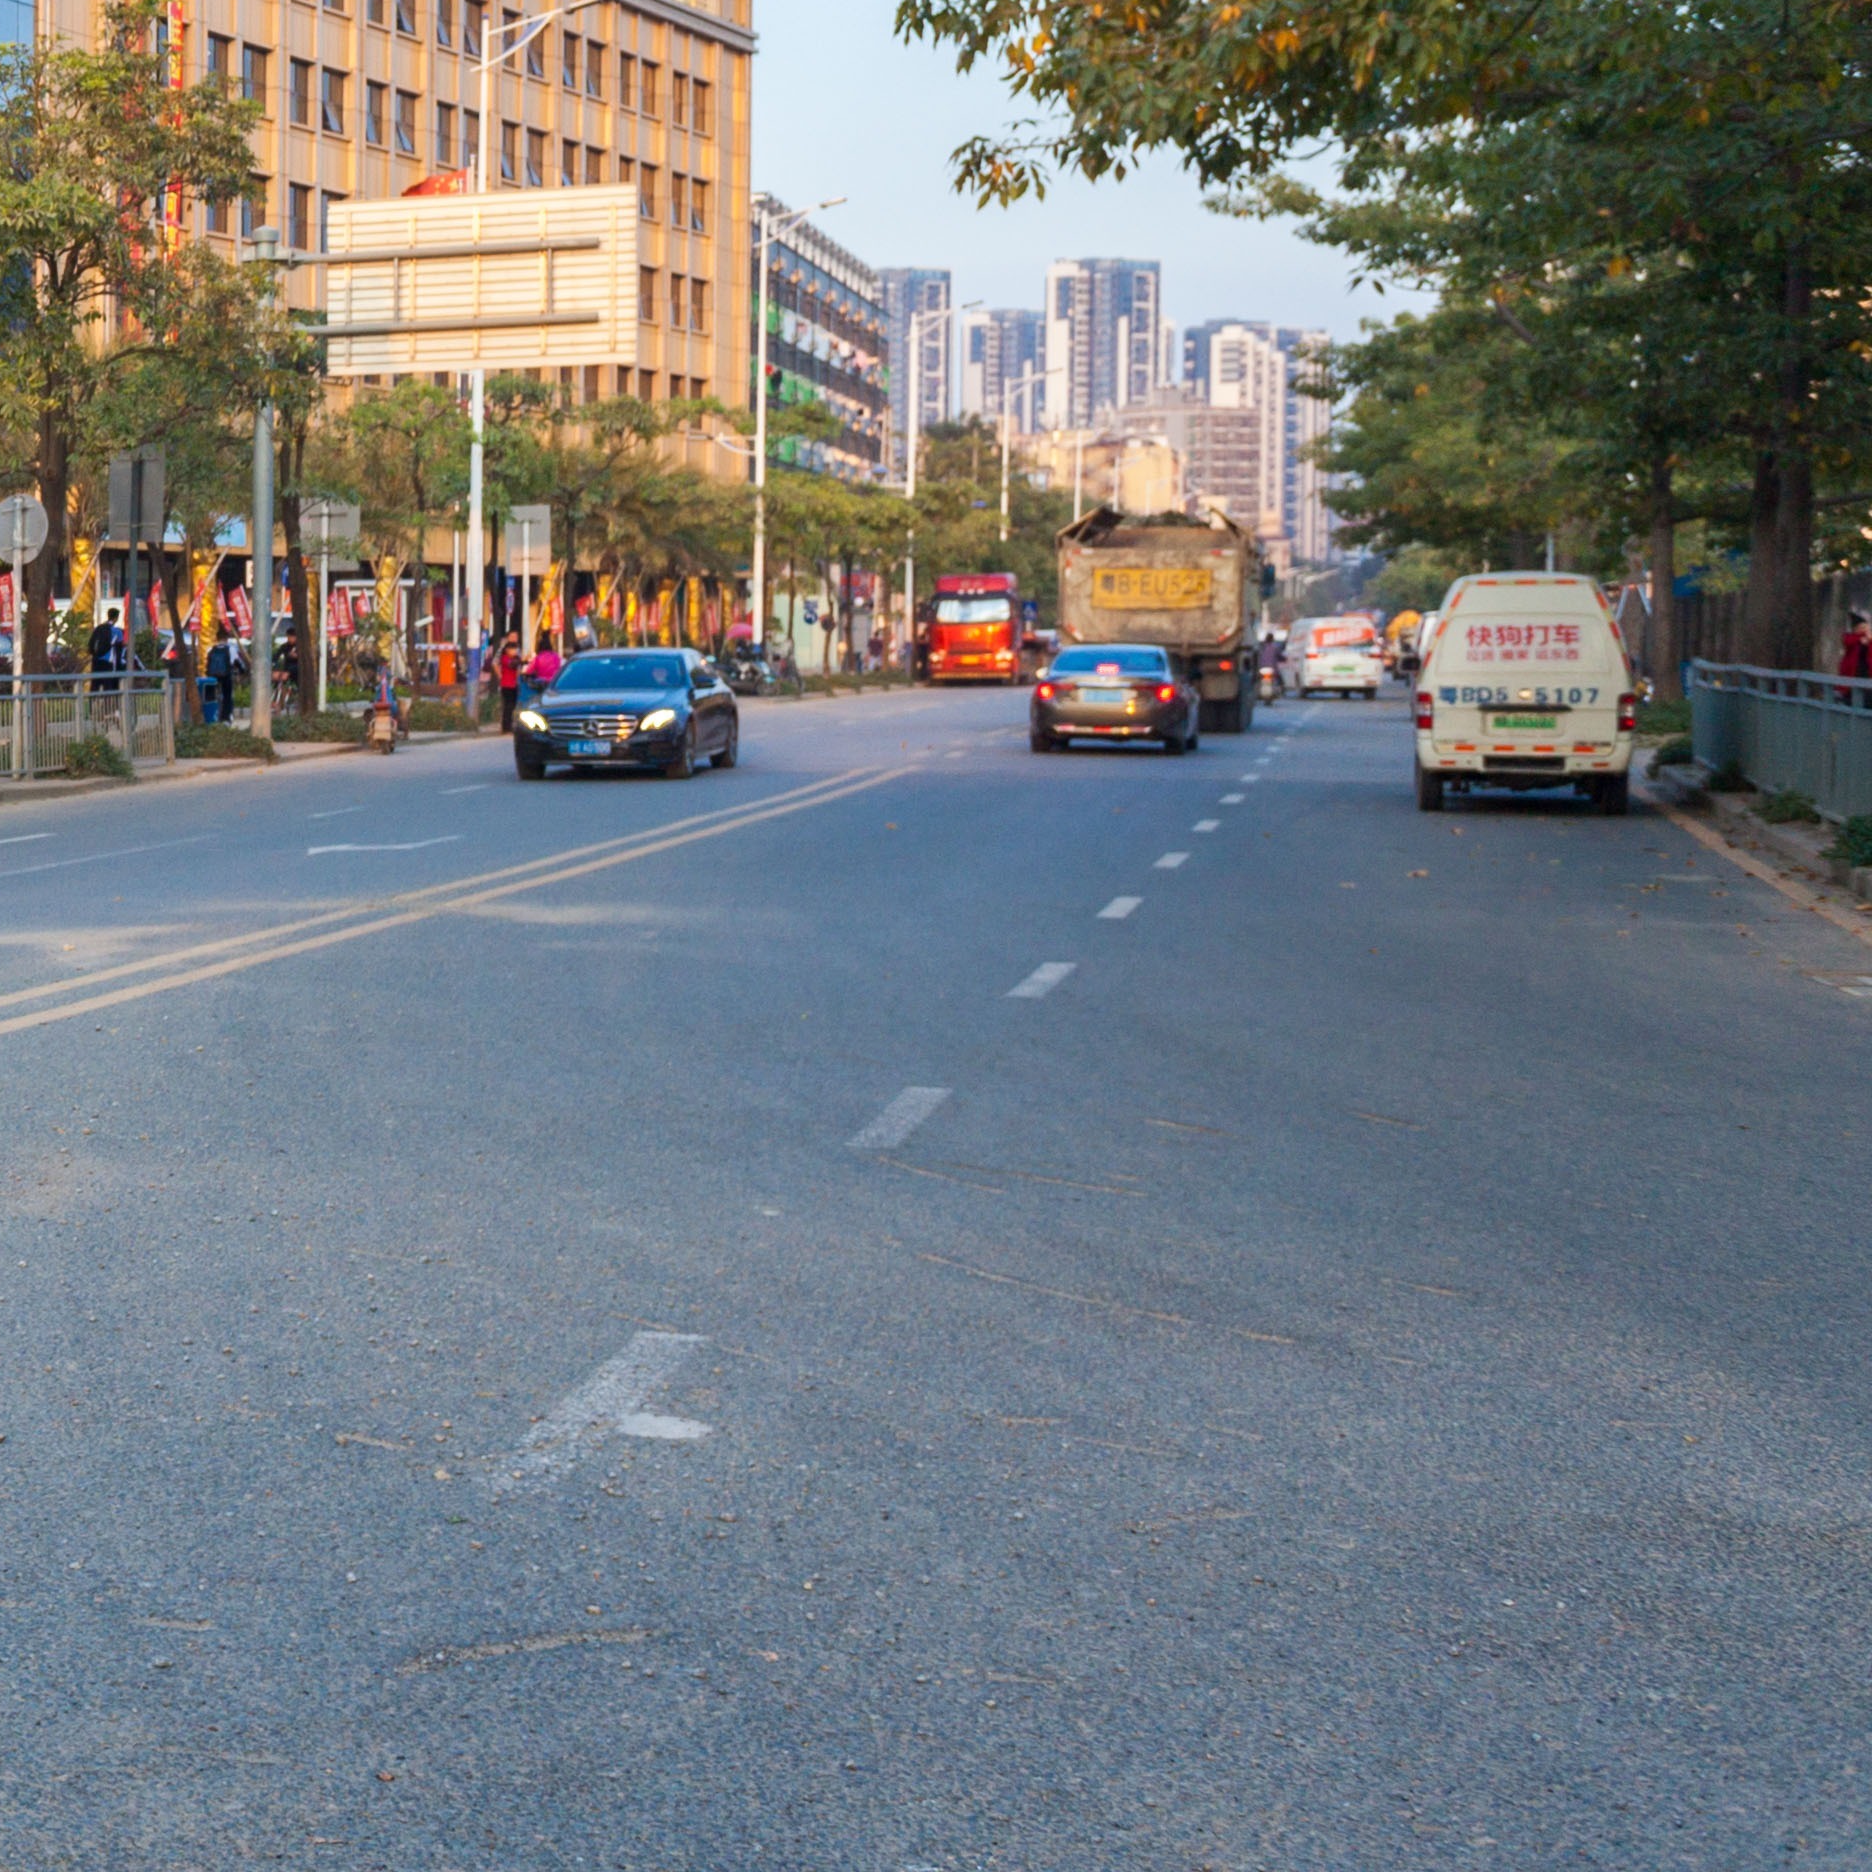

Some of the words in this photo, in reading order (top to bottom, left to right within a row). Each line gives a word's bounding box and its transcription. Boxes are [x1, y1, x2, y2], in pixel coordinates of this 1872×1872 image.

[1466, 624, 1580, 647] 快狗打车
[1535, 687, 1599, 704] 5107
